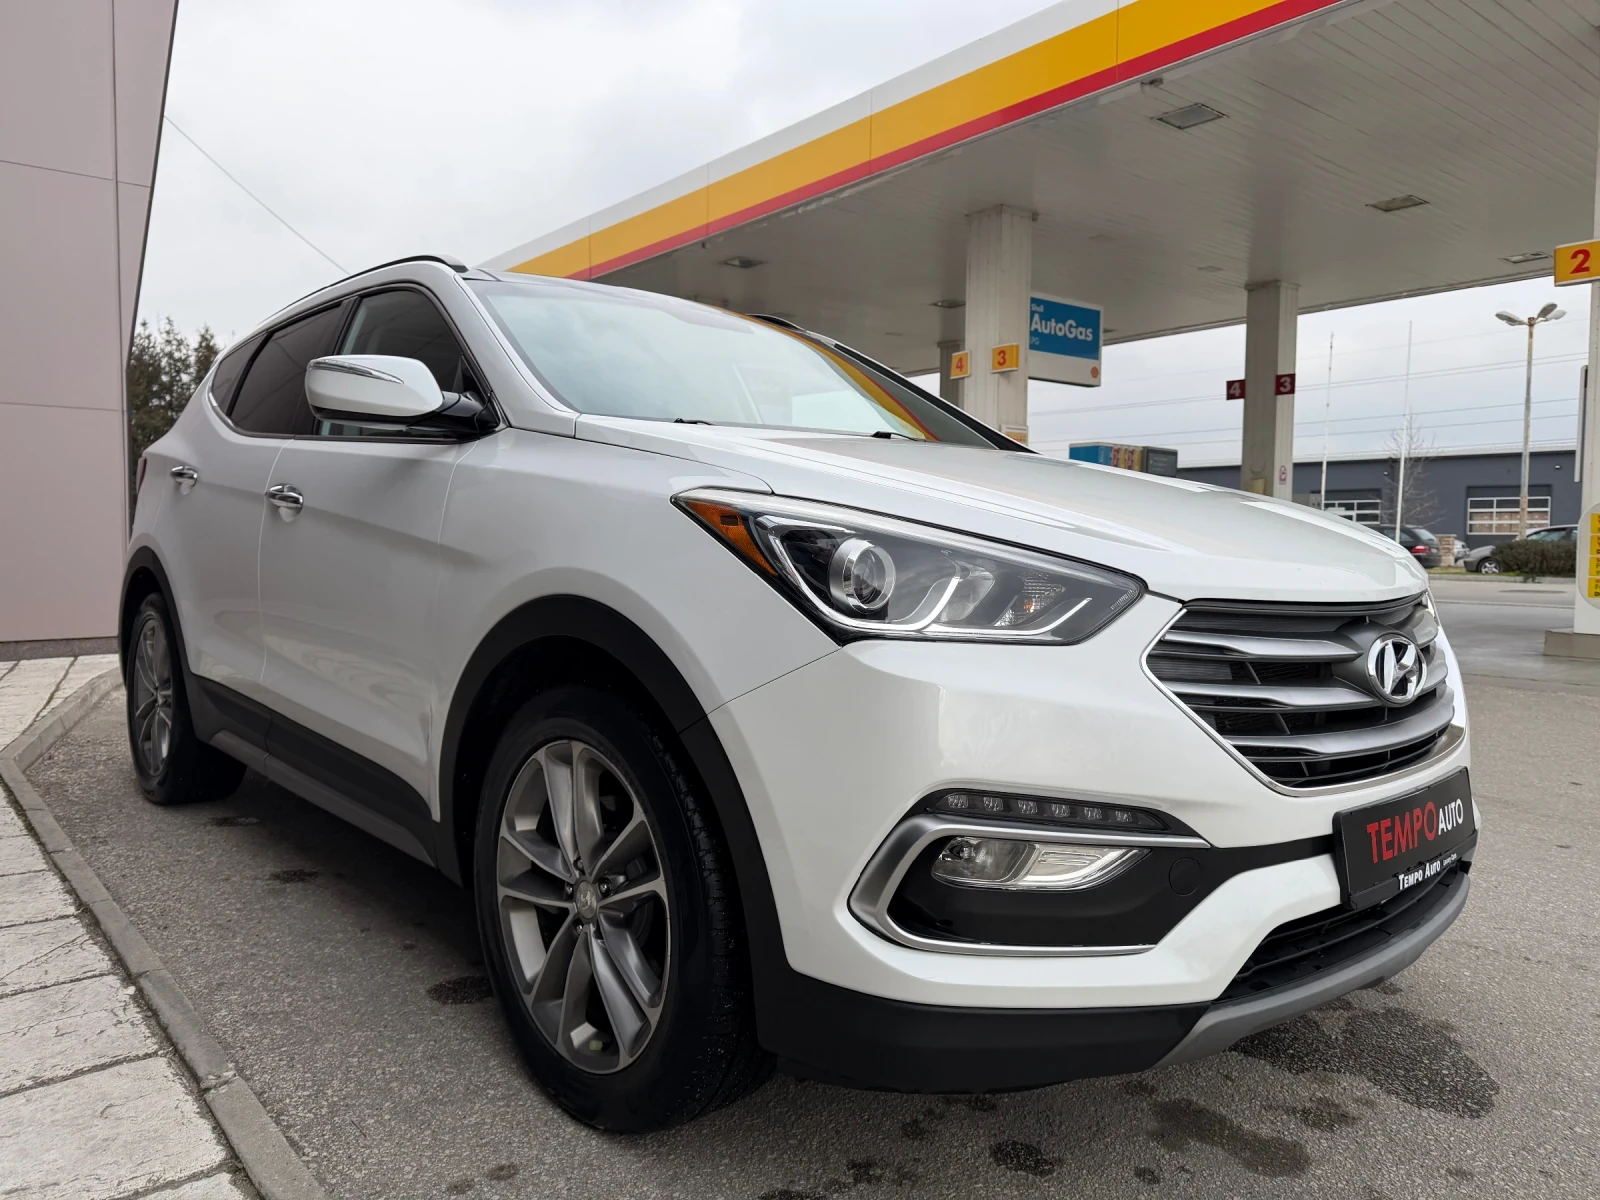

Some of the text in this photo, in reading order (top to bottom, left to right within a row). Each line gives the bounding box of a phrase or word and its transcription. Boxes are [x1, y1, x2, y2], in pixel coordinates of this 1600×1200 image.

[1569, 248, 1591, 274] 2
[1030, 313, 1093, 342] AutoGas
[955, 357, 965, 372] 4
[997, 350, 1007, 366] 3
[1229, 382, 1241, 397] 4
[1279, 377, 1291, 393] 3
[1366, 798, 1464, 864] TEMPO AUTO
